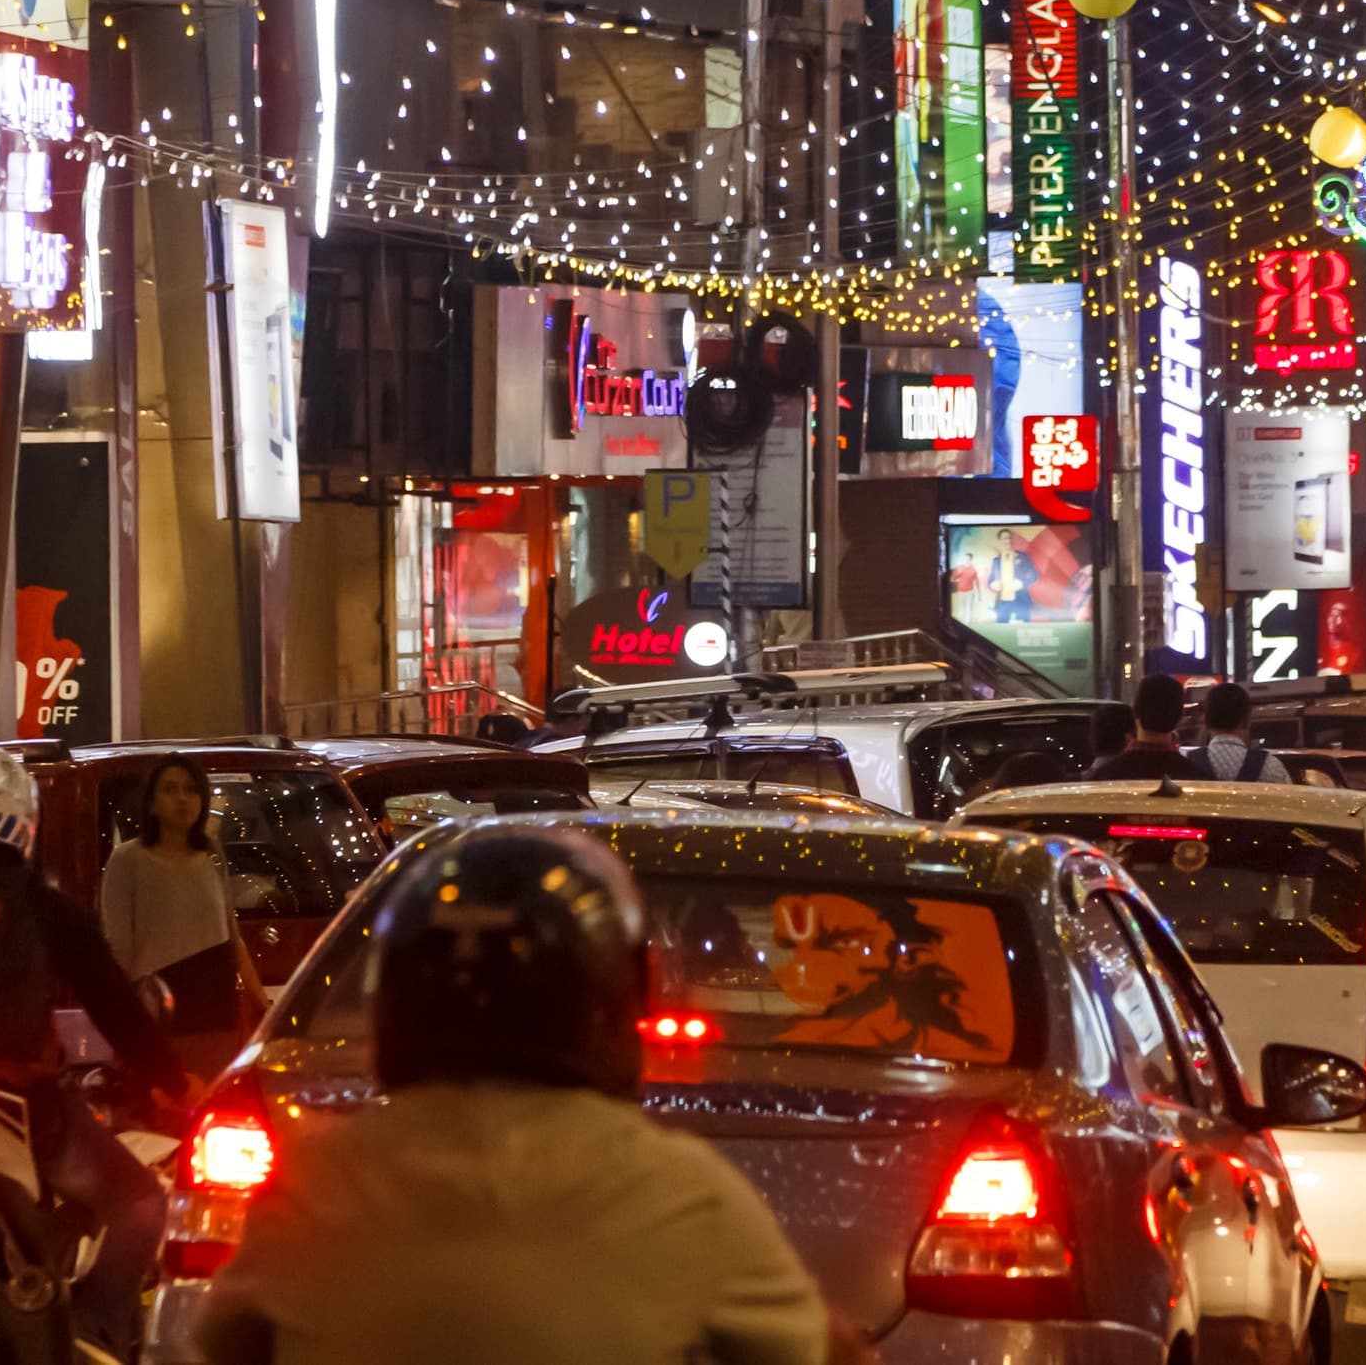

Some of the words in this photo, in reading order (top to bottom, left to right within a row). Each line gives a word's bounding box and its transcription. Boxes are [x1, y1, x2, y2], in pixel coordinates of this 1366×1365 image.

[1028, 150, 1064, 267] PETER
[1159, 256, 1206, 660] SKECHERS
[663, 473, 696, 518] P
[590, 623, 686, 655] Hotel
[37, 705, 80, 726] OFF
